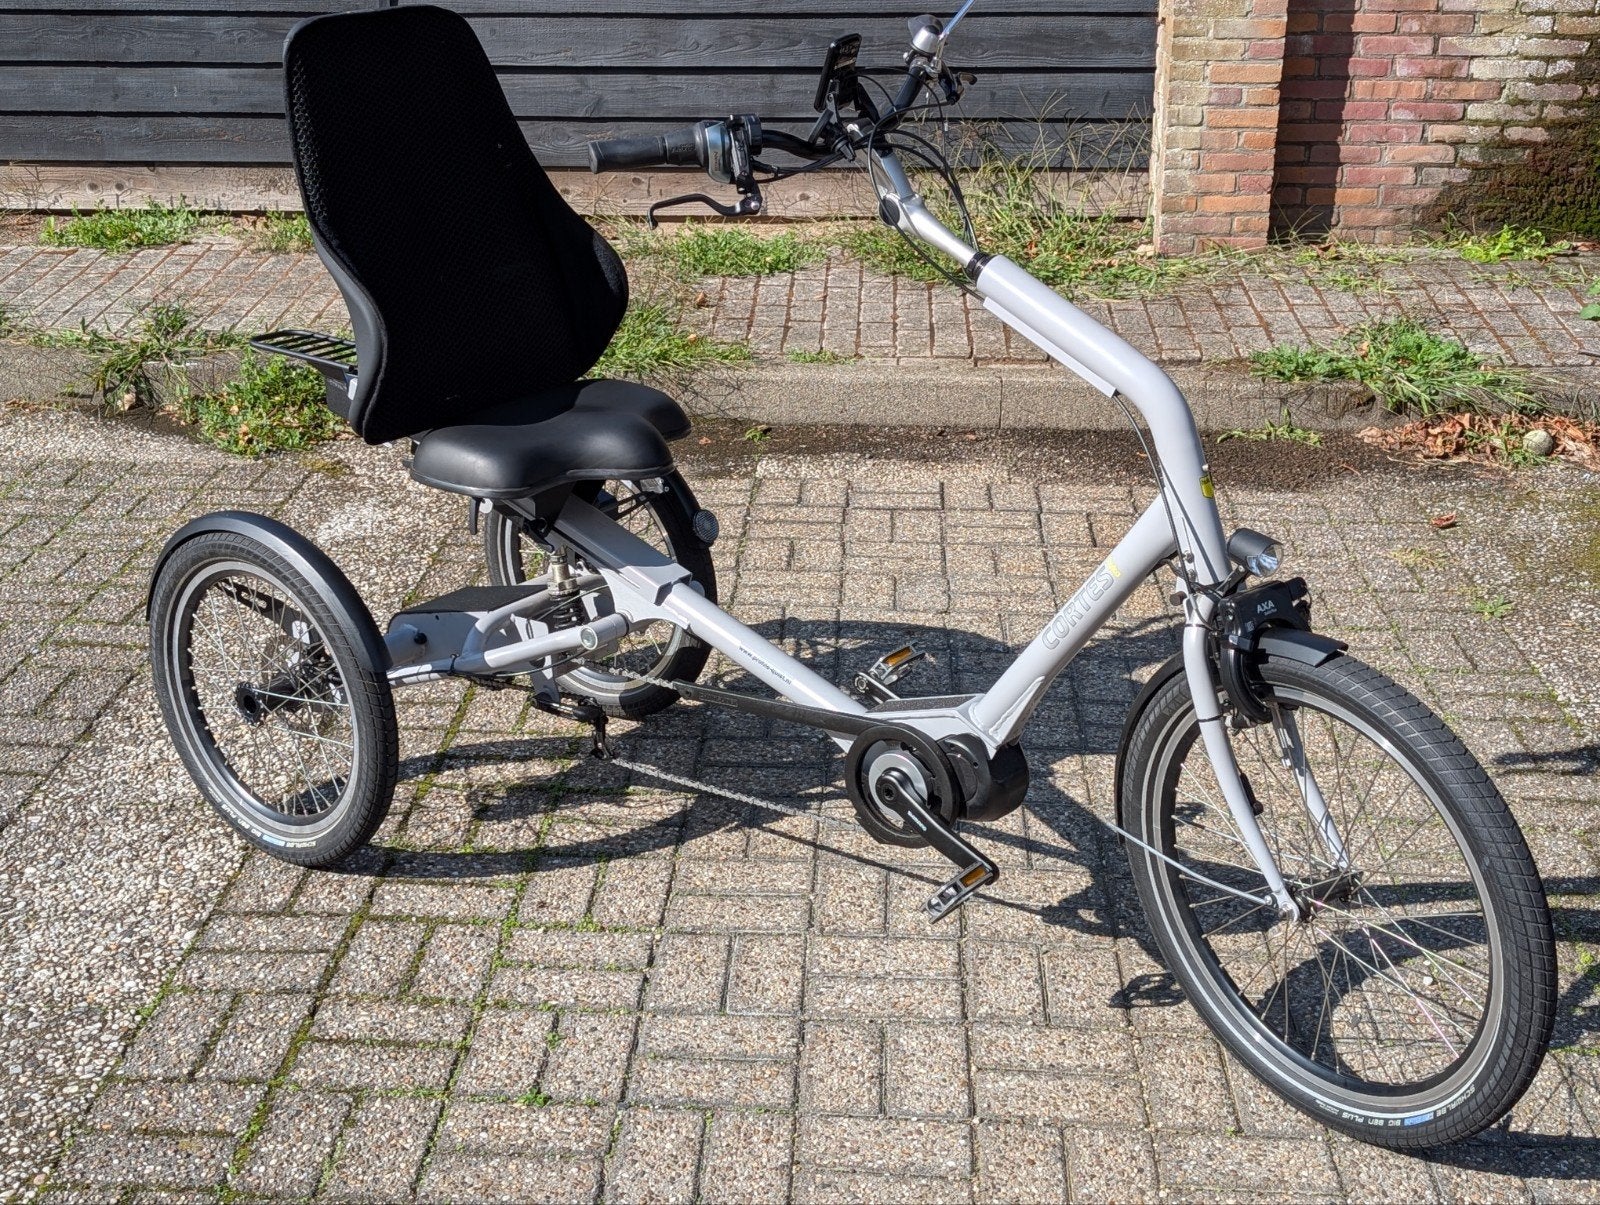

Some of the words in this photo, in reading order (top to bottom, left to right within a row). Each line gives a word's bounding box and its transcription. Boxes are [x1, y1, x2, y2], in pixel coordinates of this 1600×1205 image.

[1042, 564, 1115, 651] CORTES
[1257, 600, 1275, 614] AXA
[1436, 1083, 1476, 1117] SCHWALBE
[1341, 1111, 1365, 1123] PLUS
[1387, 1119, 1401, 1127] BIG
